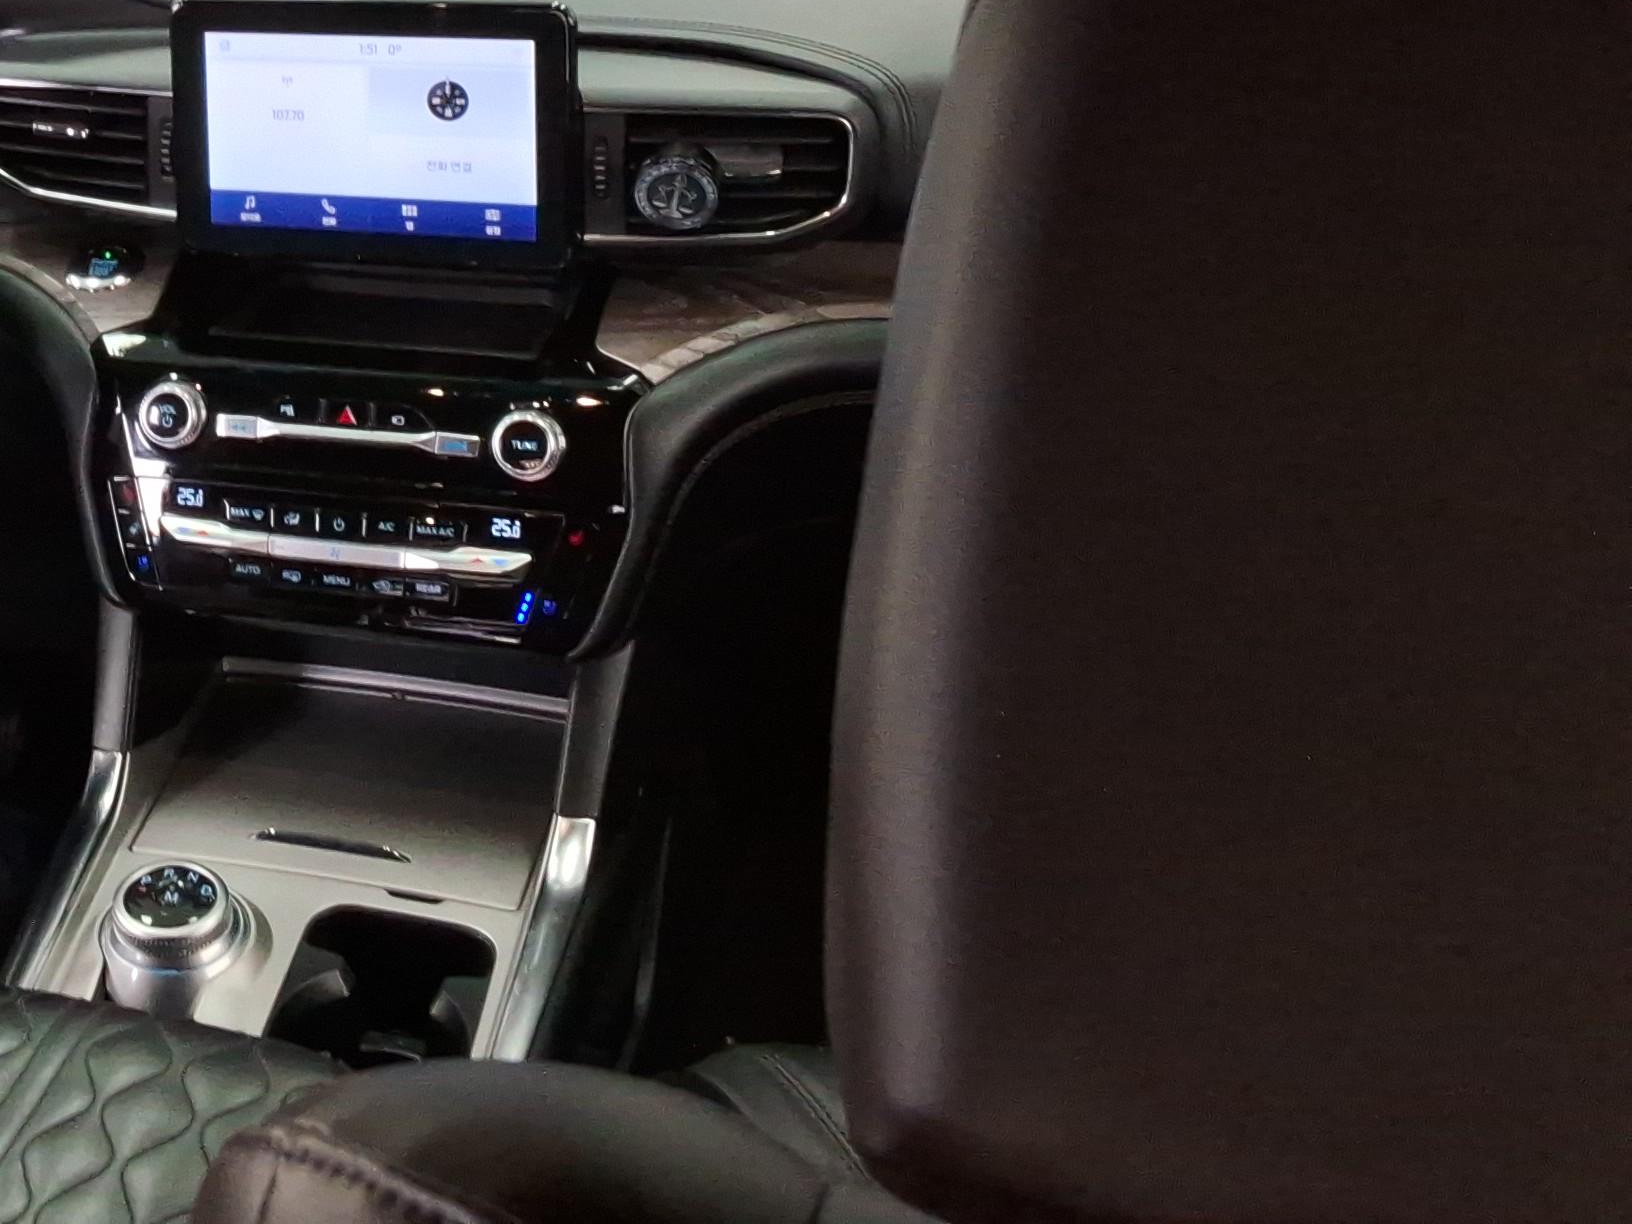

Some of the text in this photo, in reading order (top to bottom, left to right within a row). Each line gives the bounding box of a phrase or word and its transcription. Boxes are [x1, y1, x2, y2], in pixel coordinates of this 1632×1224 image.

[511, 439, 537, 451] TUNE
[236, 564, 261, 575] AUTO
[187, 871, 200, 884] N
